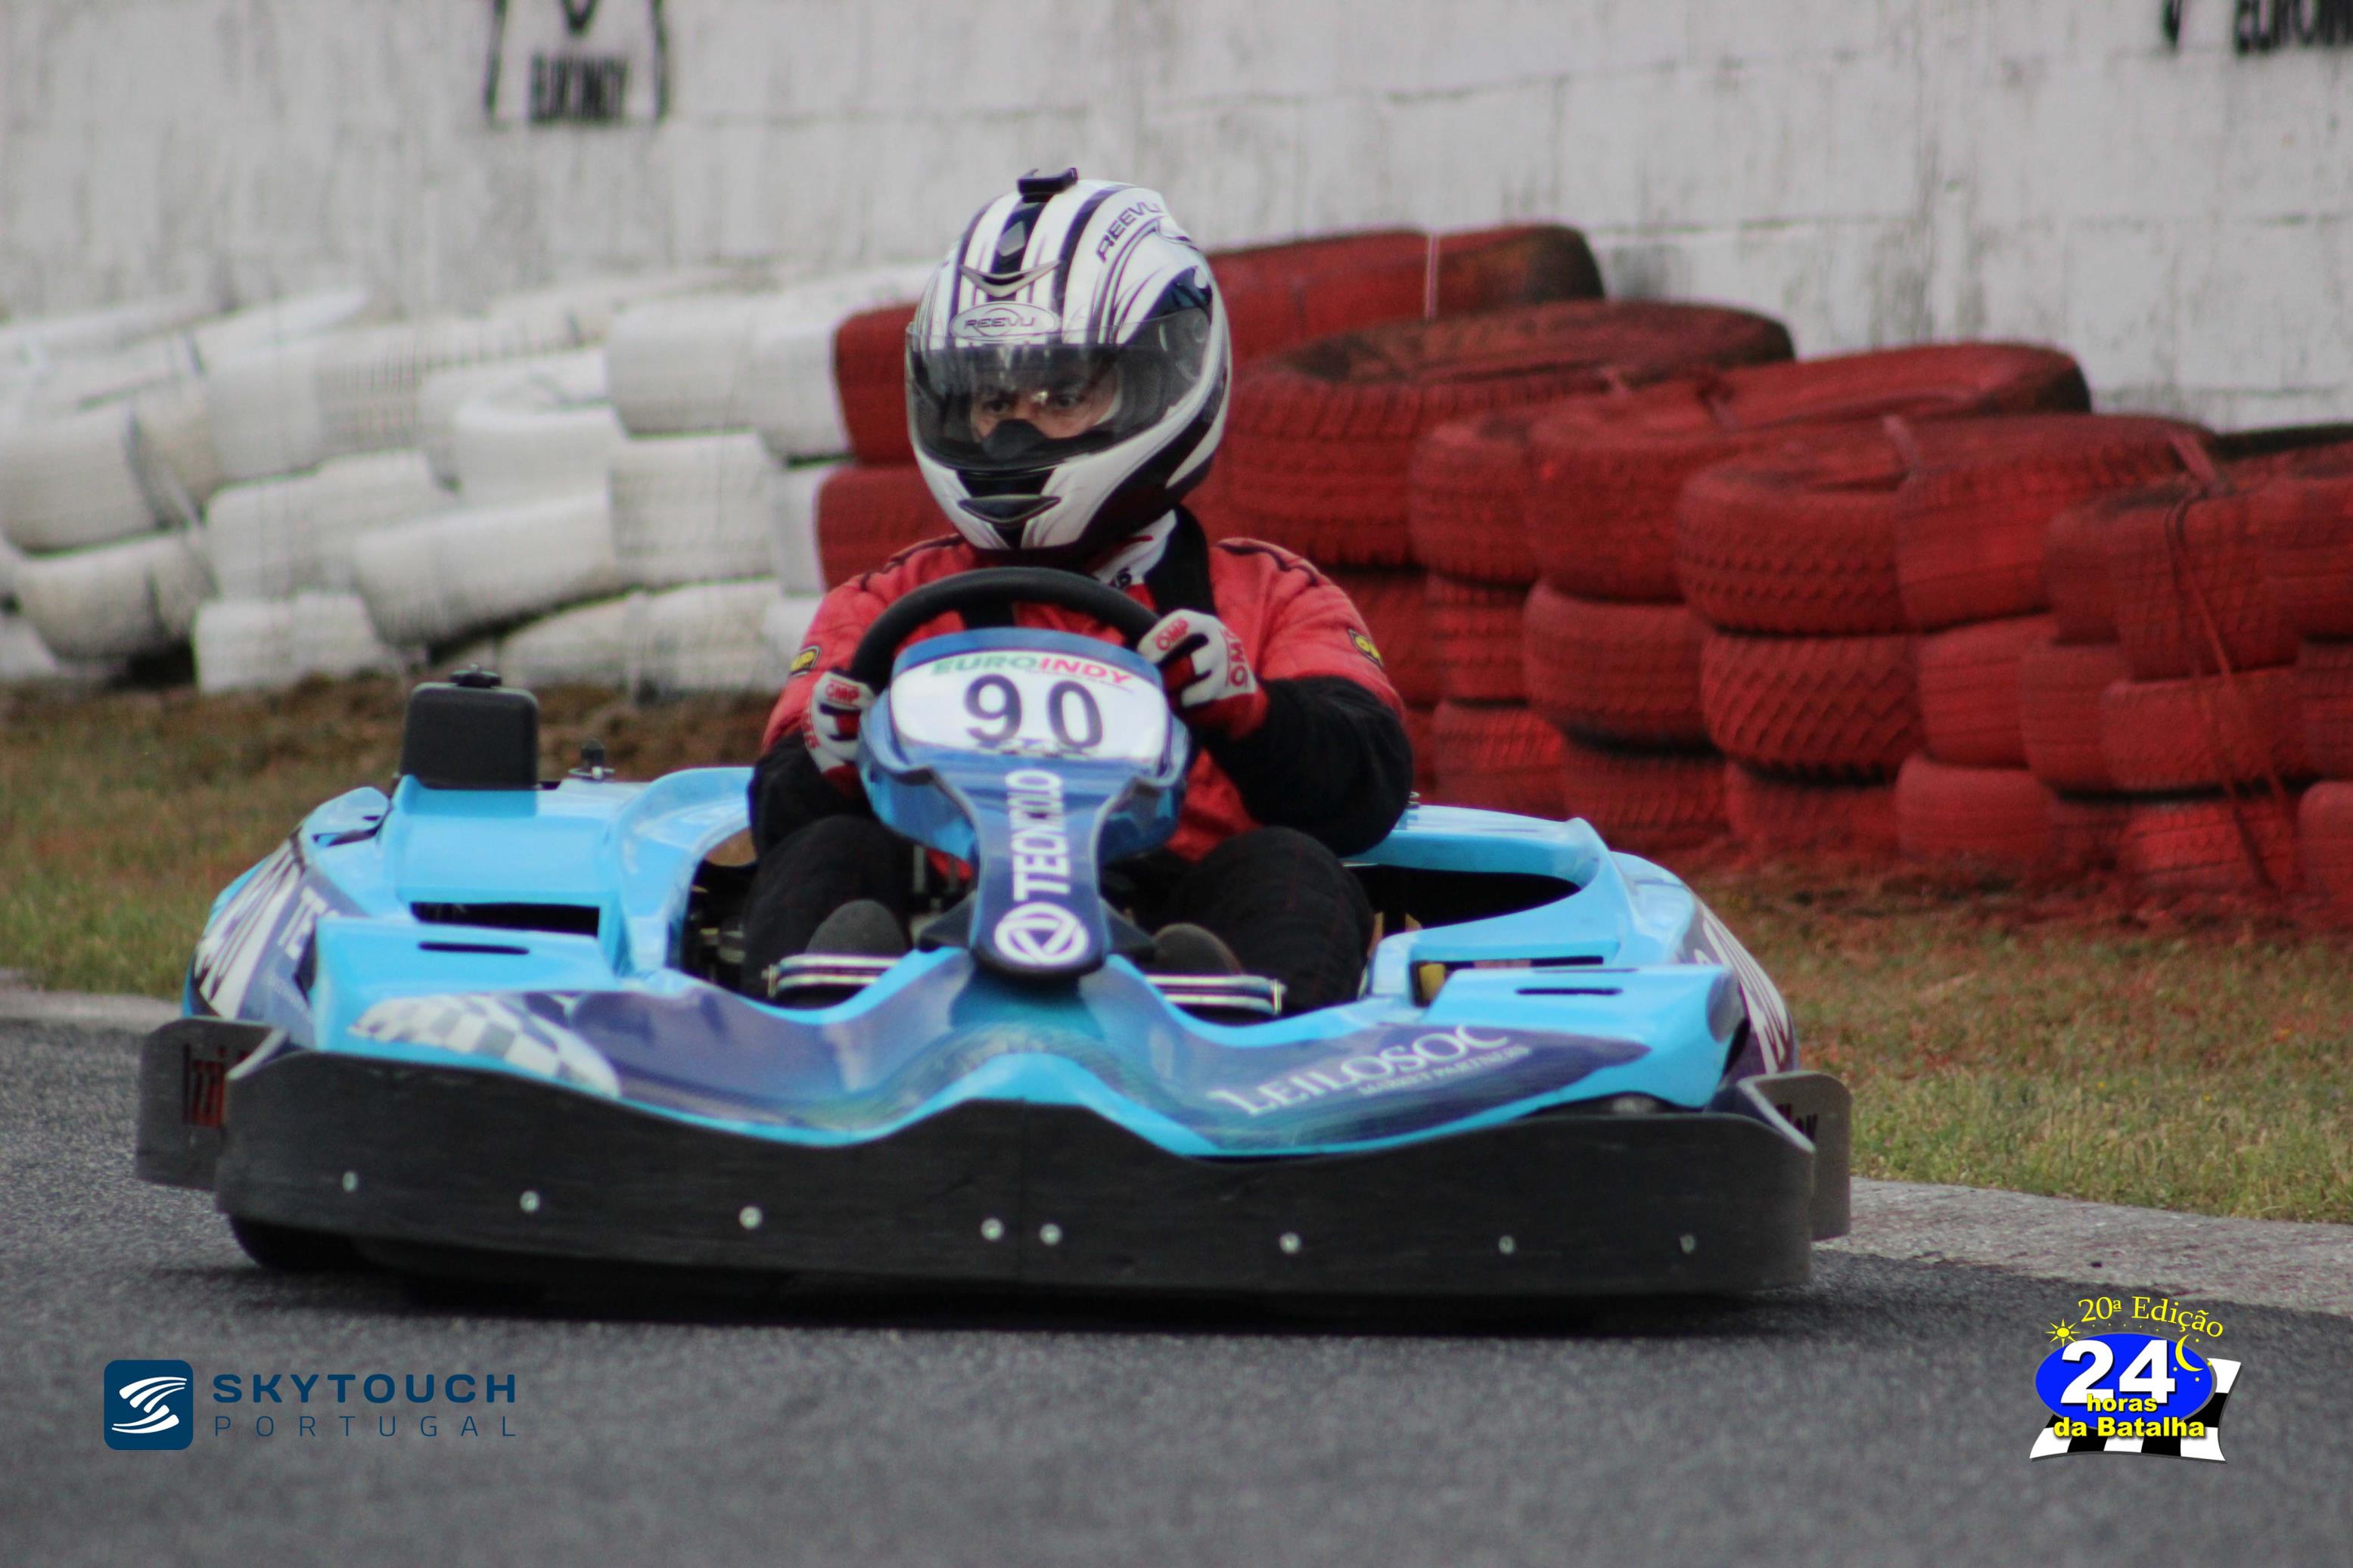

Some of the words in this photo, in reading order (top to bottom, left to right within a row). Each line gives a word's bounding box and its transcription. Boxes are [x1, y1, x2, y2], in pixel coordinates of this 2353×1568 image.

[1096, 200, 1162, 263] REEVU
[963, 315, 1037, 330] REEVU
[933, 656, 1133, 685] EUROINDY
[964, 673, 1104, 748] 90
